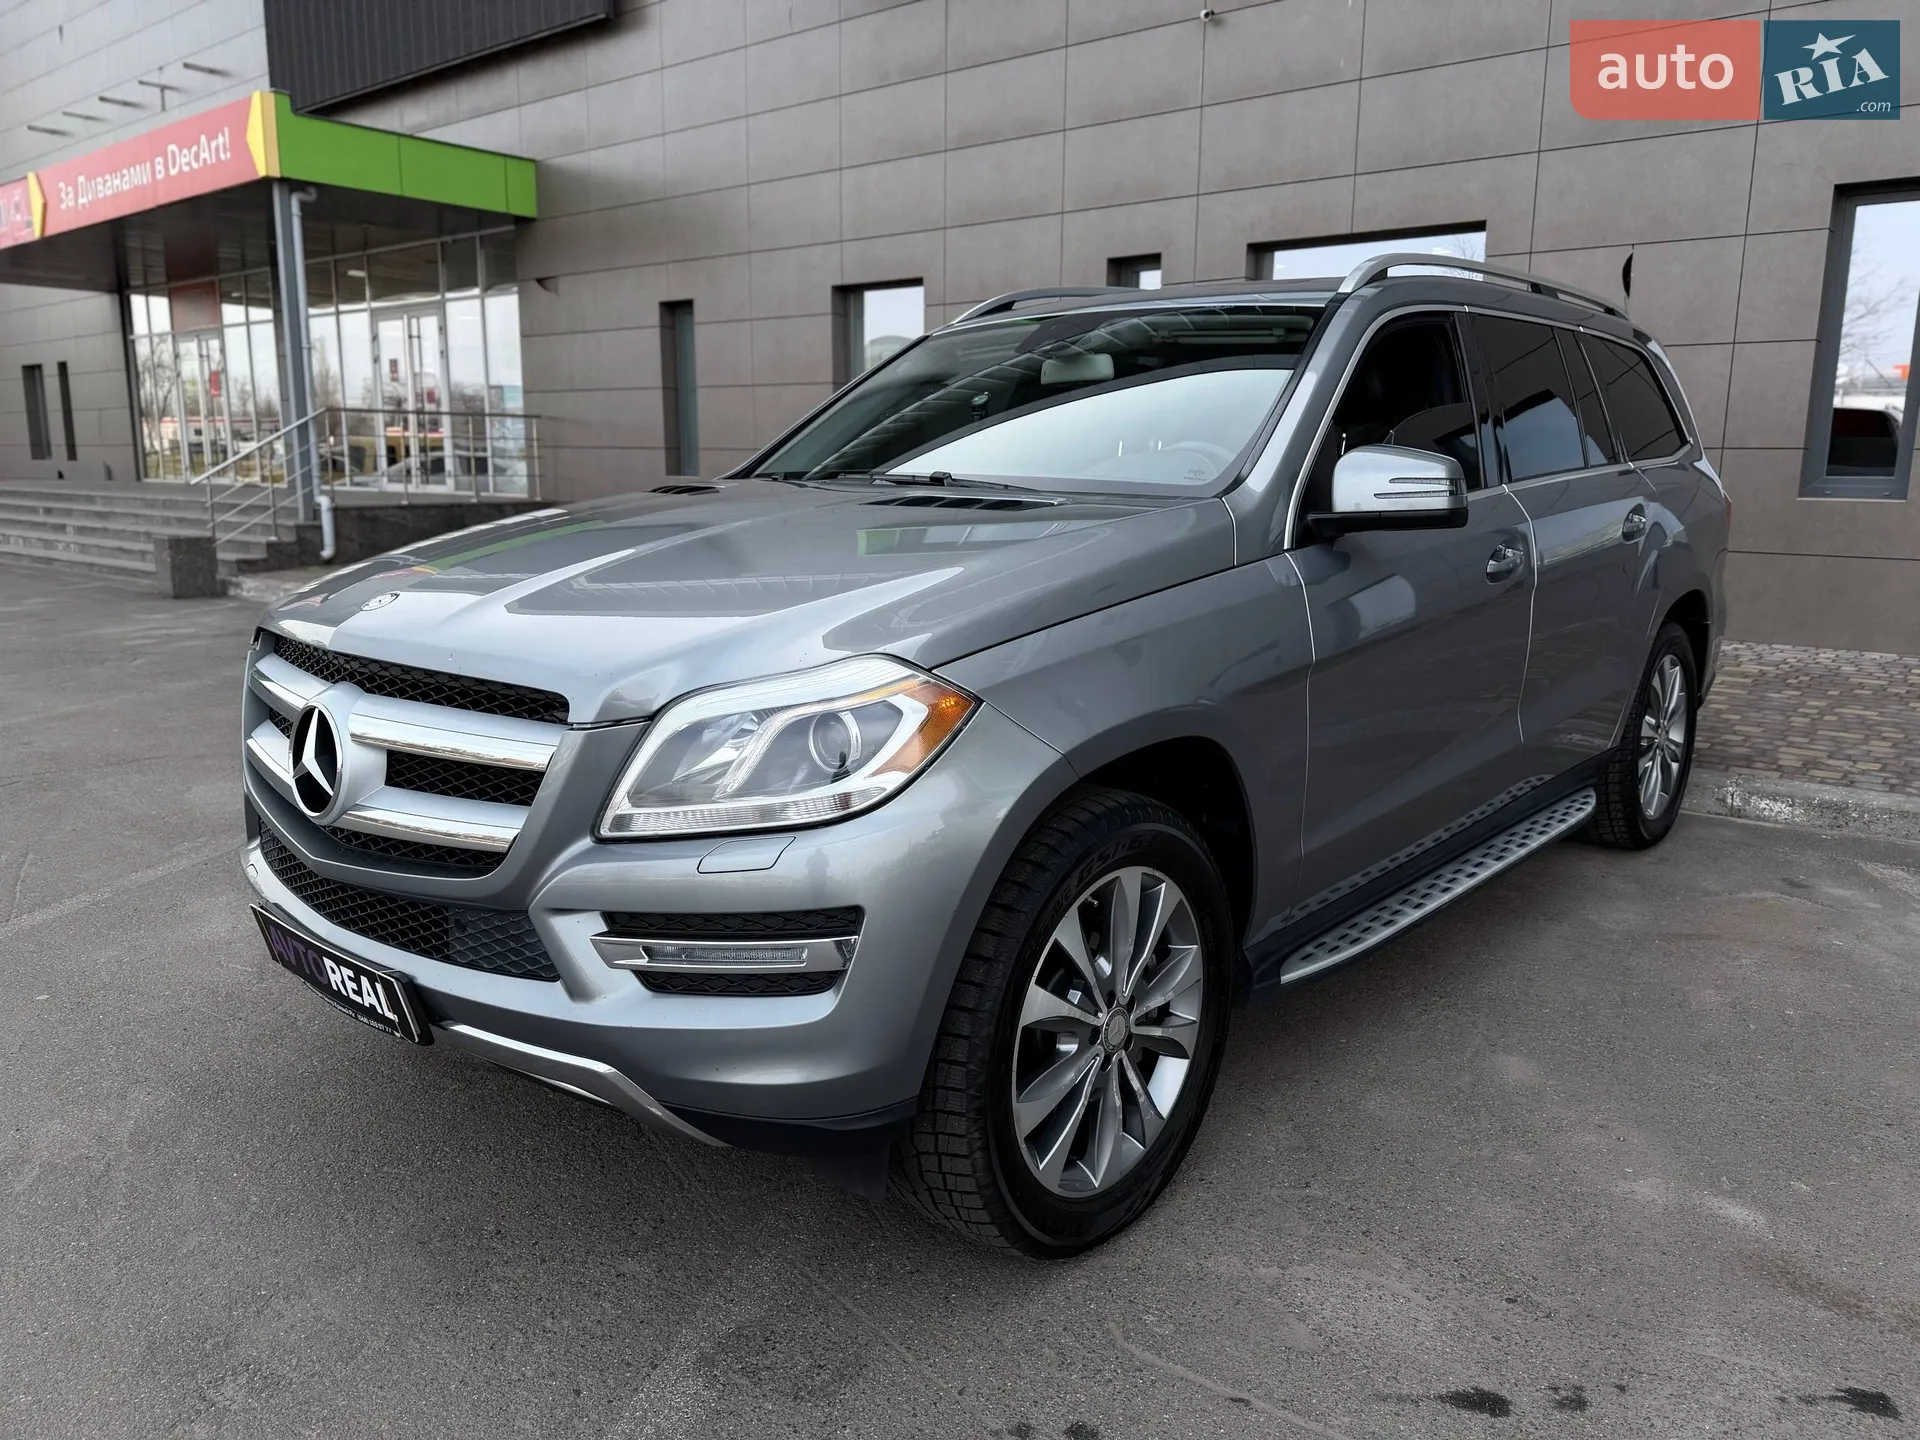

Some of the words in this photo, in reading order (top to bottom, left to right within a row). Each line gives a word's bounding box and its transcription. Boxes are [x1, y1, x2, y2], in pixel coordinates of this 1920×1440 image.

[58, 181, 76, 210] За
[77, 160, 152, 211] Диванами
[154, 156, 166, 181] в
[166, 126, 231, 177] DecArt!
